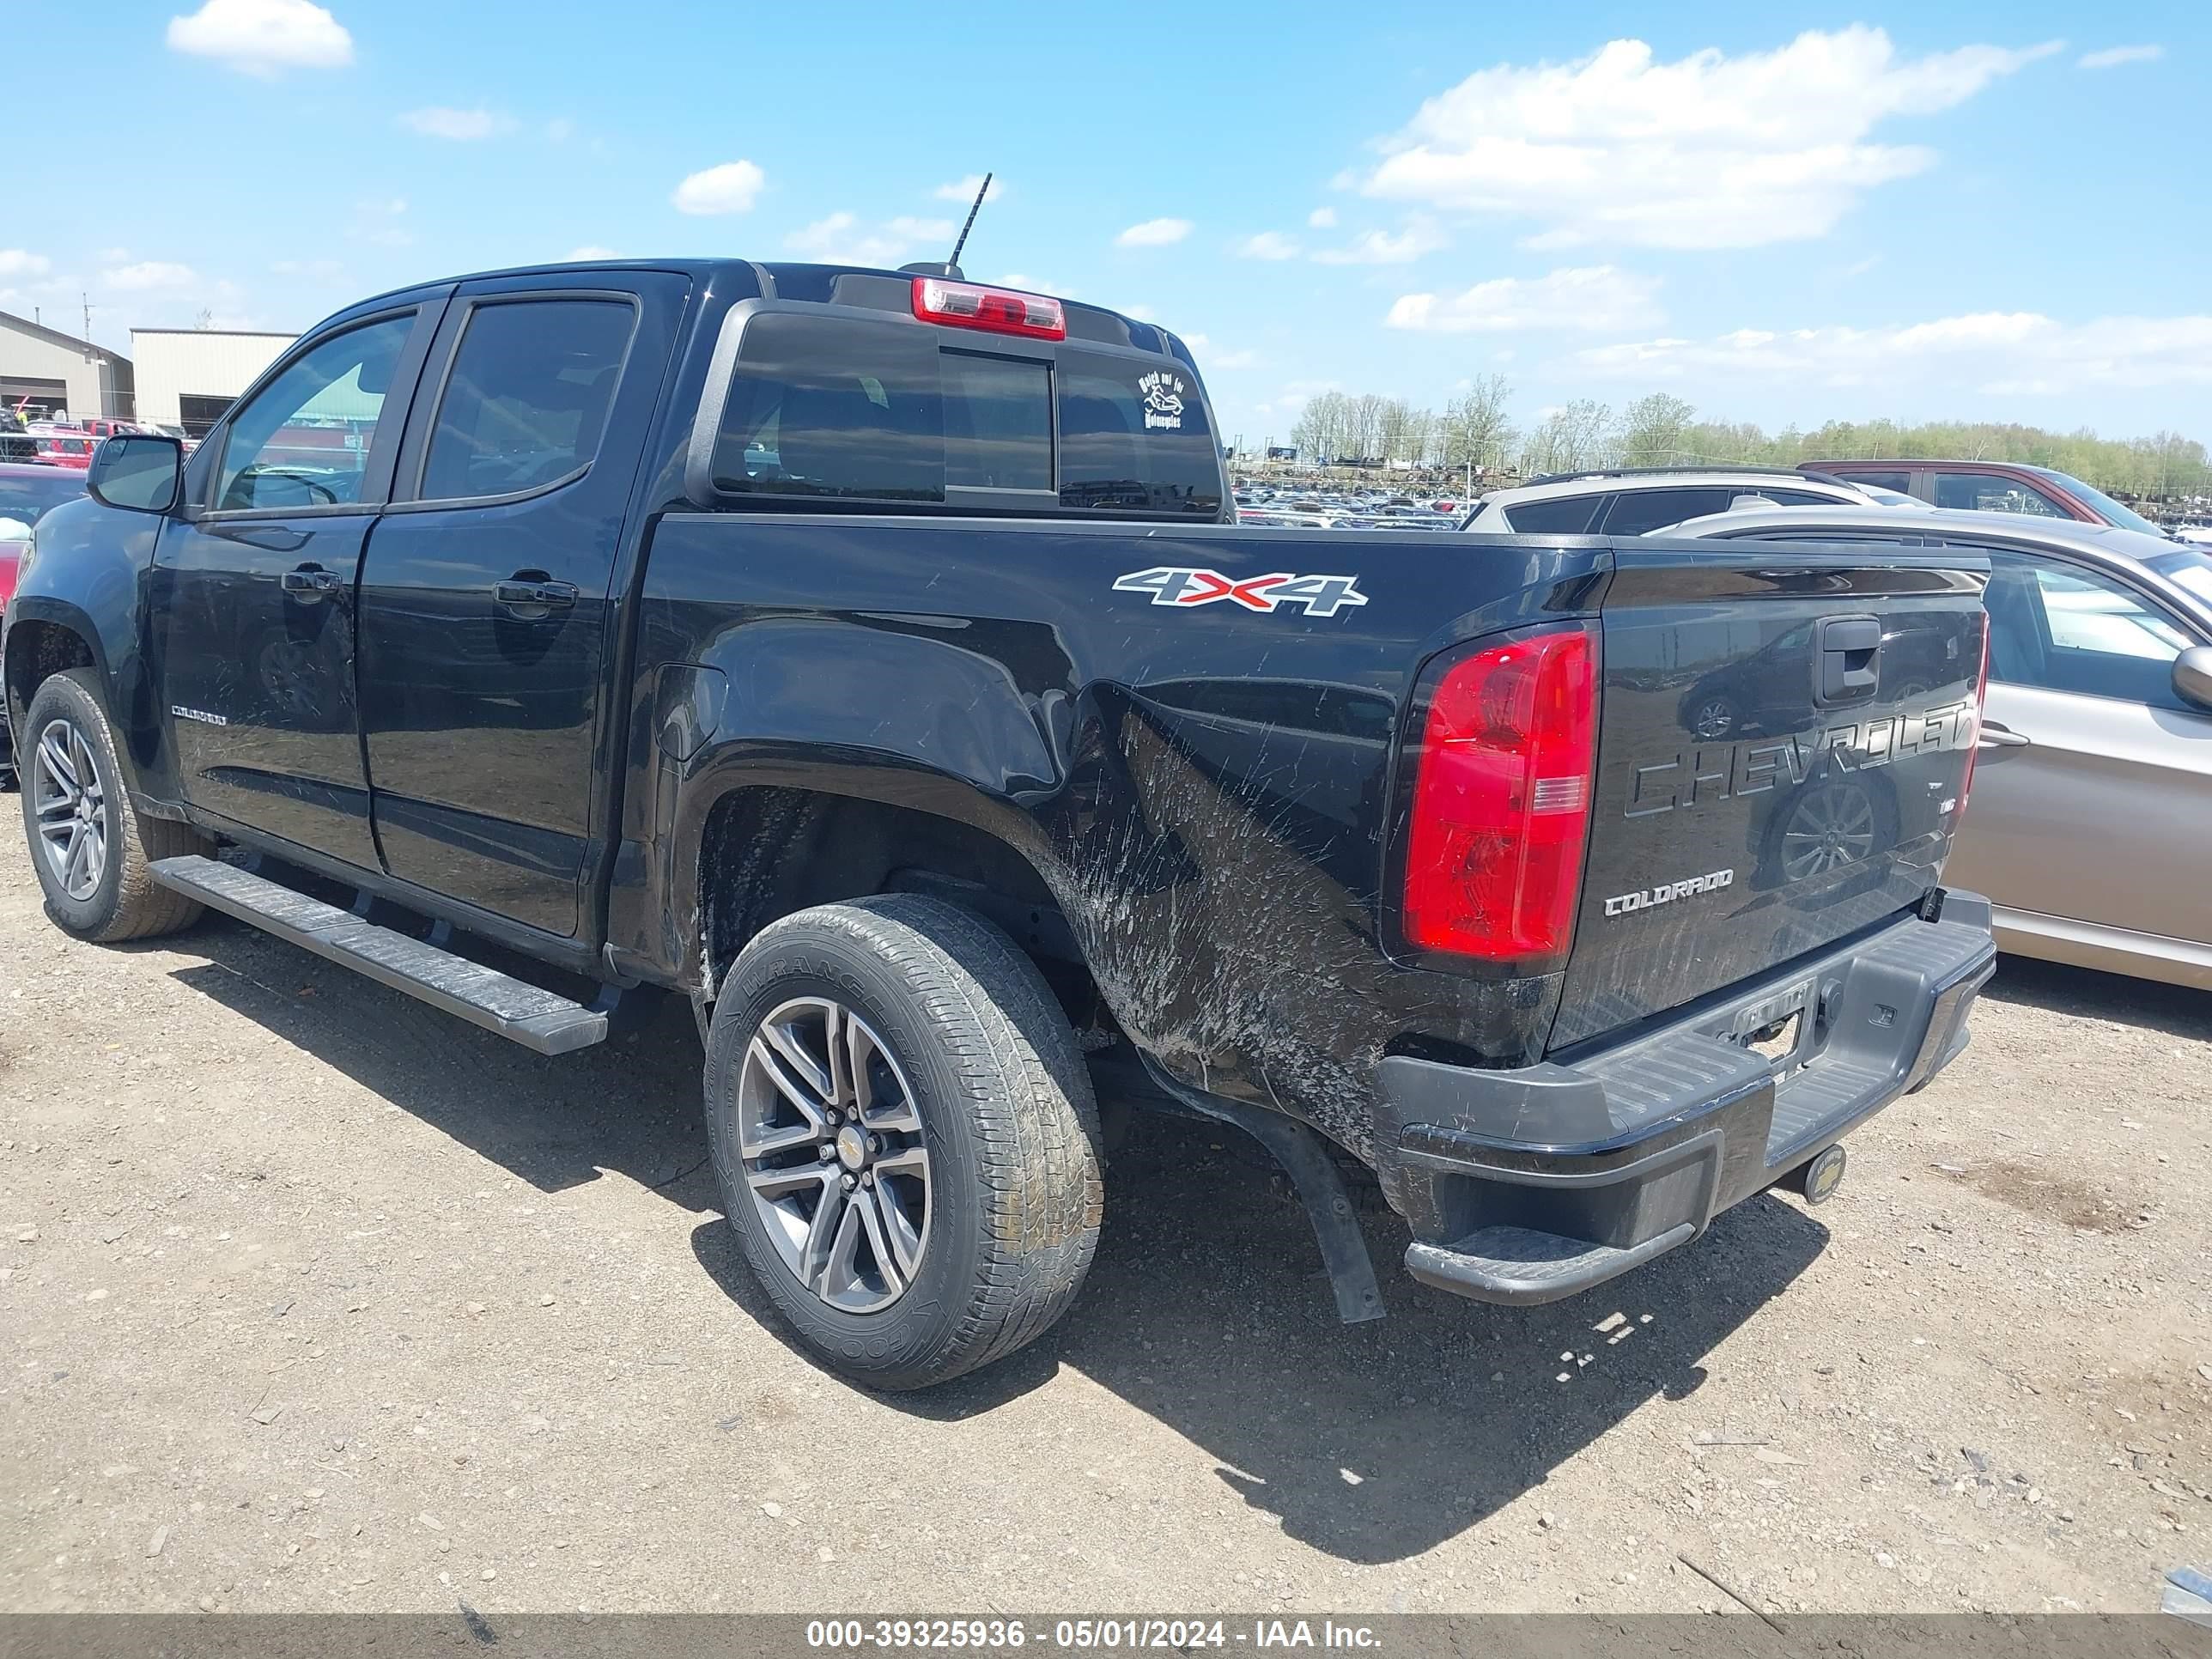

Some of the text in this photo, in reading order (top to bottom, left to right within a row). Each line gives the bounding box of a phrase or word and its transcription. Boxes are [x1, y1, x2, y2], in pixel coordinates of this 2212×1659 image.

[1138, 371, 1185, 394] Watch out for
[1145, 413, 1182, 430] Motorcycles
[1624, 701, 1968, 819] CHEVROLET
[1603, 868, 1735, 917] COLORADO
[742, 955, 932, 1096] WRANGLER
[726, 1201, 911, 1360] GOODYEAR
